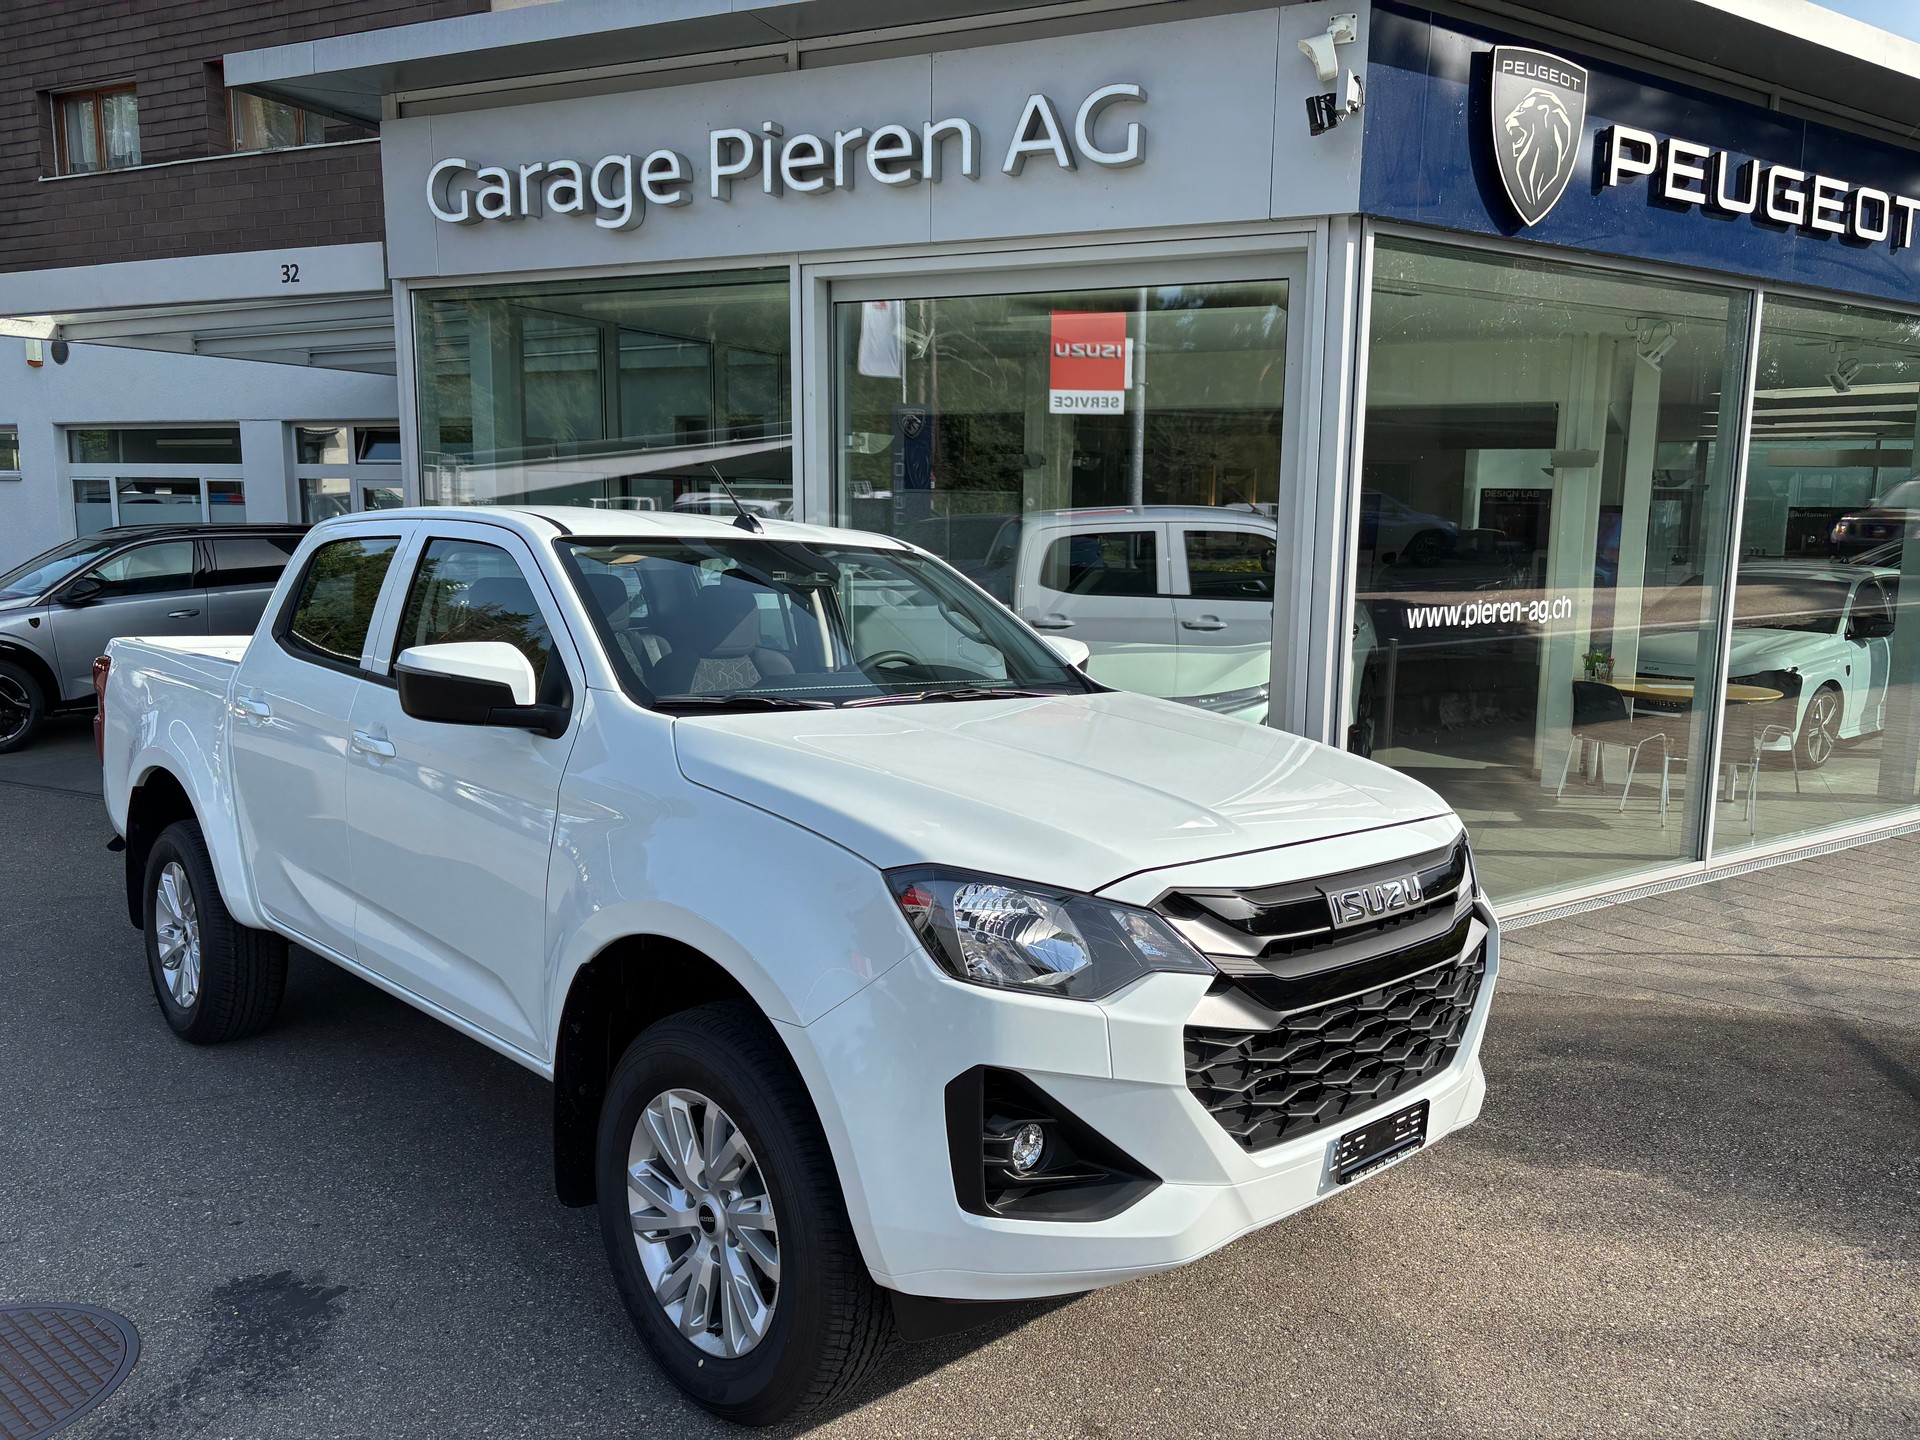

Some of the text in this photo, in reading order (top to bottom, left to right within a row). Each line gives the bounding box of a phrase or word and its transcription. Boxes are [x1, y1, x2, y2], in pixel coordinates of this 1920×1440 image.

[1502, 60, 1581, 90] PEUGEOT
[426, 83, 1146, 230] Garage Pieren AG
[1604, 124, 1920, 249] PEUGEOT
[281, 263, 300, 283] 32
[1484, 490, 1540, 498] DESIGN LAB
[1406, 595, 1572, 629] www.pieren-ag.ch
[1330, 874, 1421, 924] ISUZU
